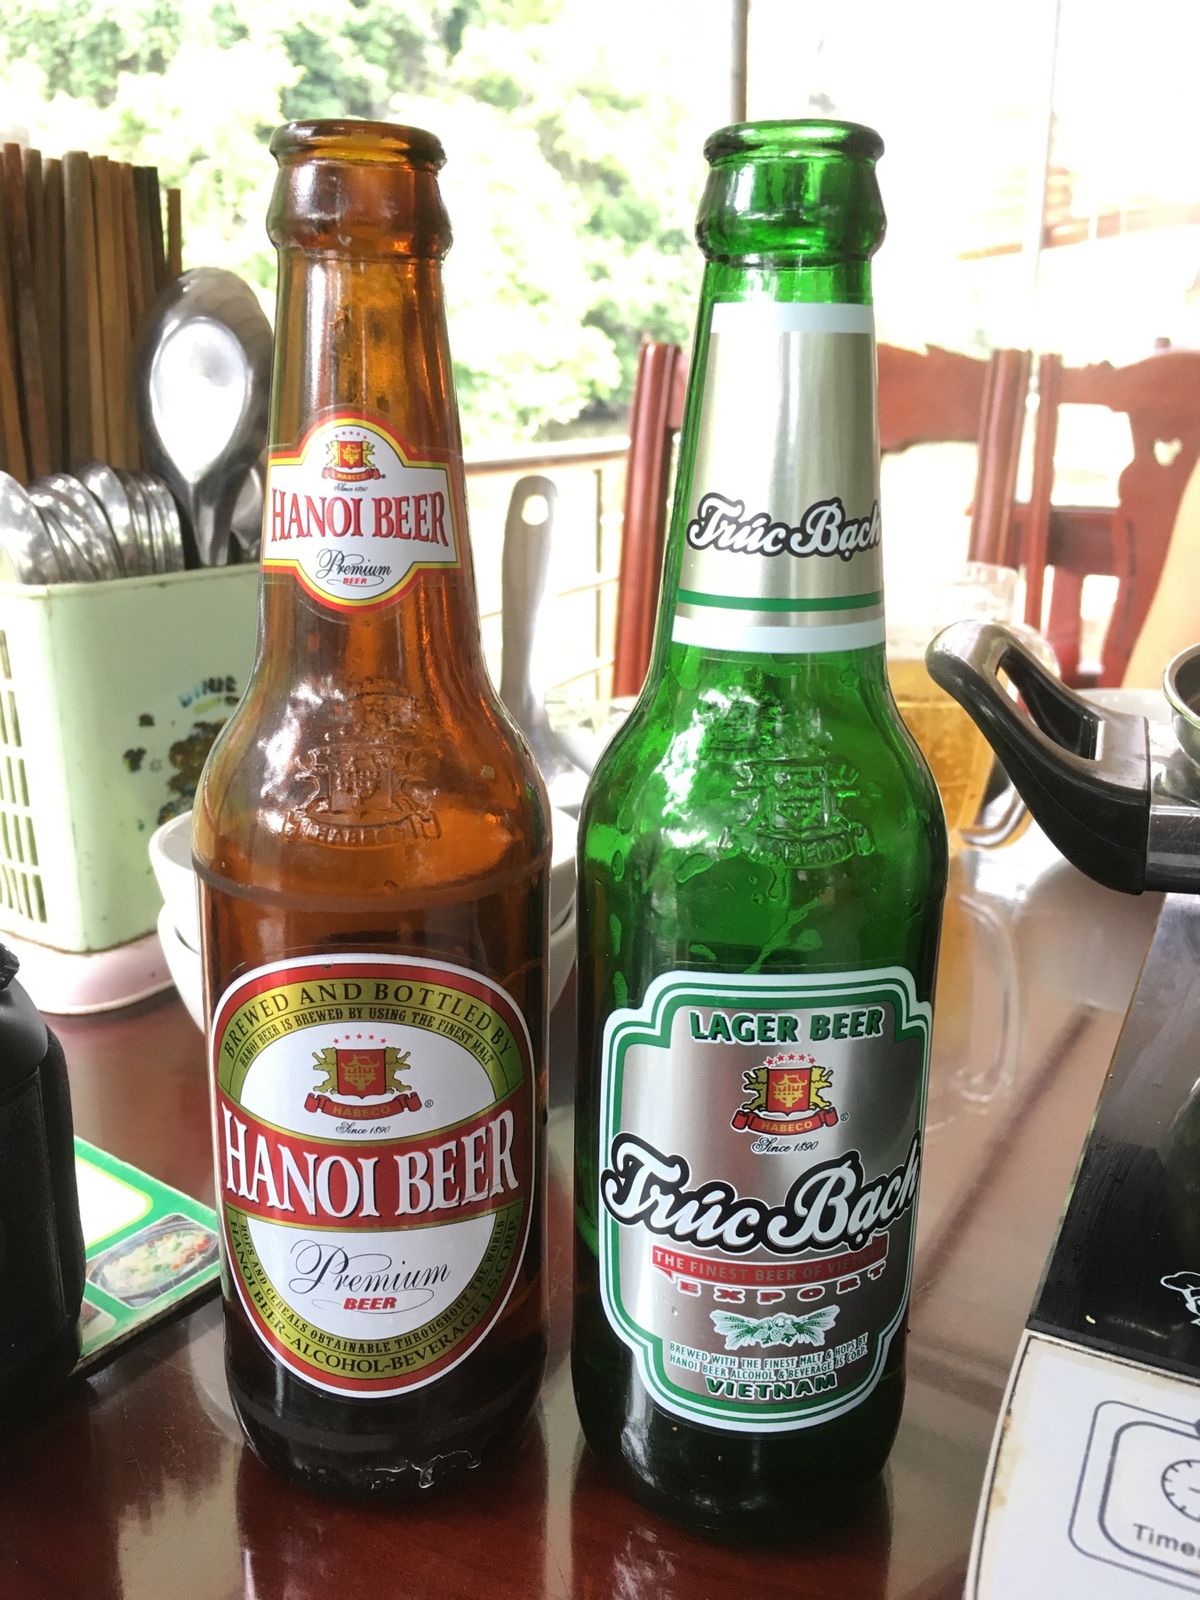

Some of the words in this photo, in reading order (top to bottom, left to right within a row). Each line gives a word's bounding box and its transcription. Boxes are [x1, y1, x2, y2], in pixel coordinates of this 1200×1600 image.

[271, 487, 364, 542] HANOI
[372, 491, 449, 547] BEER
[687, 493, 787, 556] Trúc
[315, 548, 392, 579] Premium
[342, 577, 368, 585] BEER
[223, 993, 289, 1060] BREWED
[300, 983, 362, 1005] AND
[374, 983, 492, 1031] BOTTLED
[490, 1027, 512, 1057] BY
[240, 1040, 260, 1069] HANOI
[257, 1024, 281, 1045] BEER
[280, 1018, 293, 1031] IS
[294, 1008, 343, 1027] BREWED
[348, 1007, 364, 1019] BY
[369, 1007, 407, 1022] USING
[411, 1011, 435, 1027] THE
[436, 1019, 474, 1044] FINEST
[470, 1039, 495, 1065] MALT
[689, 1010, 800, 1043] LAGER
[808, 1007, 885, 1042] BEER
[333, 1105, 391, 1117] HABECO
[335, 1121, 368, 1135] Since
[369, 1125, 391, 1134] 1890
[761, 1120, 813, 1132] HABECO
[221, 1101, 380, 1218] HANOI
[393, 1109, 519, 1216] BEER
[752, 1137, 791, 1153] Since
[793, 1140, 819, 1152] 1890
[602, 1135, 761, 1250] Trúc
[230, 1221, 256, 1288] HANOI
[289, 1239, 451, 1294] Premium
[655, 1248, 685, 1270] THE
[690, 1258, 748, 1280] FINEST
[755, 1268, 797, 1281] BEER
[803, 1266, 822, 1279] OF
[240, 1224, 256, 1256] HOPS
[251, 1260, 268, 1285] AND
[266, 1287, 309, 1333] CEREALS
[310, 1329, 391, 1354] OBTAINABLE
[394, 1293, 470, 1350] THROUGHOUT
[468, 1267, 489, 1294] THE
[485, 1219, 506, 1264] WORLD
[678, 1261, 887, 1304] EXPORT
[343, 1296, 398, 1311] BEER
[669, 1342, 708, 1362] BREWED
[711, 1353, 737, 1367] WITH
[741, 1358, 761, 1369] THE
[764, 1357, 796, 1369] FINEST
[800, 1351, 825, 1366] MALT
[825, 1349, 833, 1360] &
[834, 1339, 856, 1356] HOPS
[856, 1332, 869, 1347] BY
[669, 1353, 698, 1371] HANOI
[702, 1364, 727, 1377] BEER
[731, 1368, 775, 1381] ALCOHOL
[778, 1369, 787, 1380] &
[788, 1362, 833, 1380] BEVERAGE
[706, 1373, 837, 1399] VIETNAM
[1133, 1523, 1200, 1560] Time
